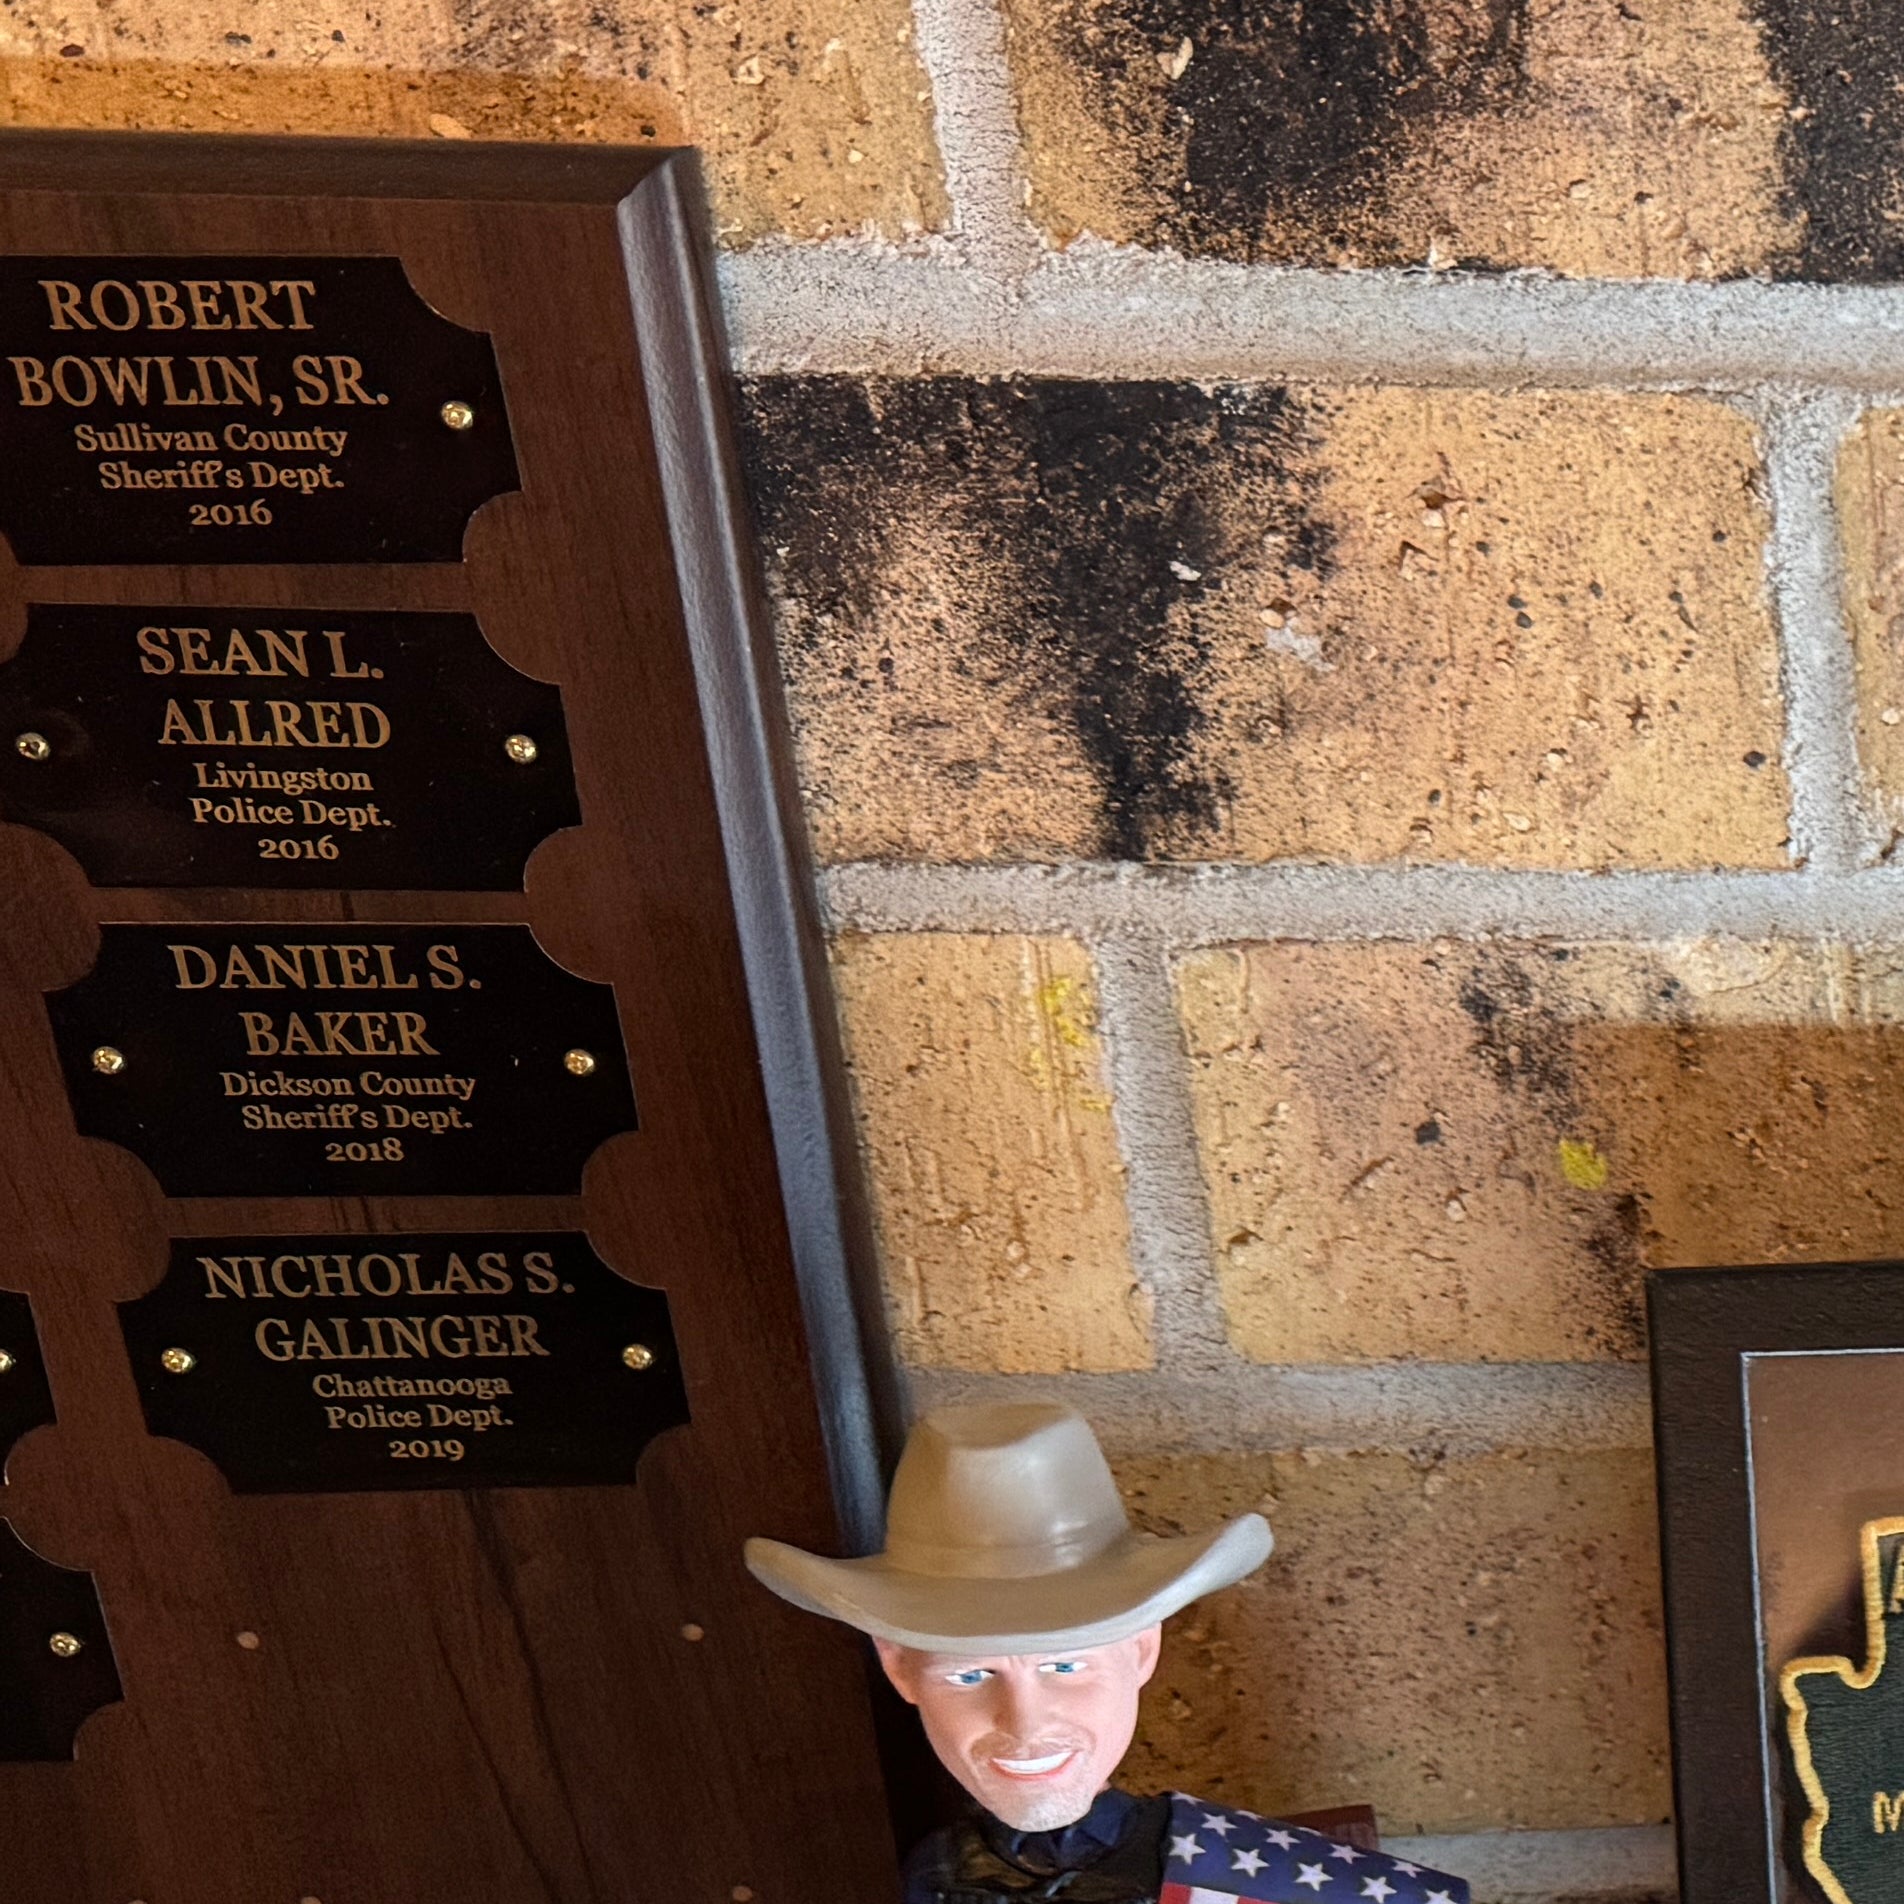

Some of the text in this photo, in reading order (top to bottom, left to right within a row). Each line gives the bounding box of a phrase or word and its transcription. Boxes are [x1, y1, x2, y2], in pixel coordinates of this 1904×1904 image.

[37, 280, 316, 331] ROBERT
[8, 356, 389, 416] BOWLIN, SR.
[75, 423, 348, 457] Sullivan County
[99, 461, 345, 494] Sheriff's Dept.
[189, 498, 273, 526] 2016
[136, 627, 384, 680] SEAN L.
[157, 698, 392, 751] ALLRED
[193, 763, 374, 796] Livingston
[189, 798, 392, 832] Police Dept.
[258, 835, 340, 860] 2016
[168, 944, 483, 990] DANIEL S.
[239, 1011, 440, 1057] BAKER
[220, 1072, 476, 1101] Dickson County
[242, 1104, 472, 1133] Sheriff's Dept.
[325, 1138, 405, 1163] 2018
[198, 1253, 575, 1298] NICHOLAS S.
[254, 1316, 550, 1362] GALINGER
[312, 1374, 513, 1400] Chattanooga
[325, 1405, 514, 1432] Police Dept.
[389, 1438, 465, 1462] 2019
